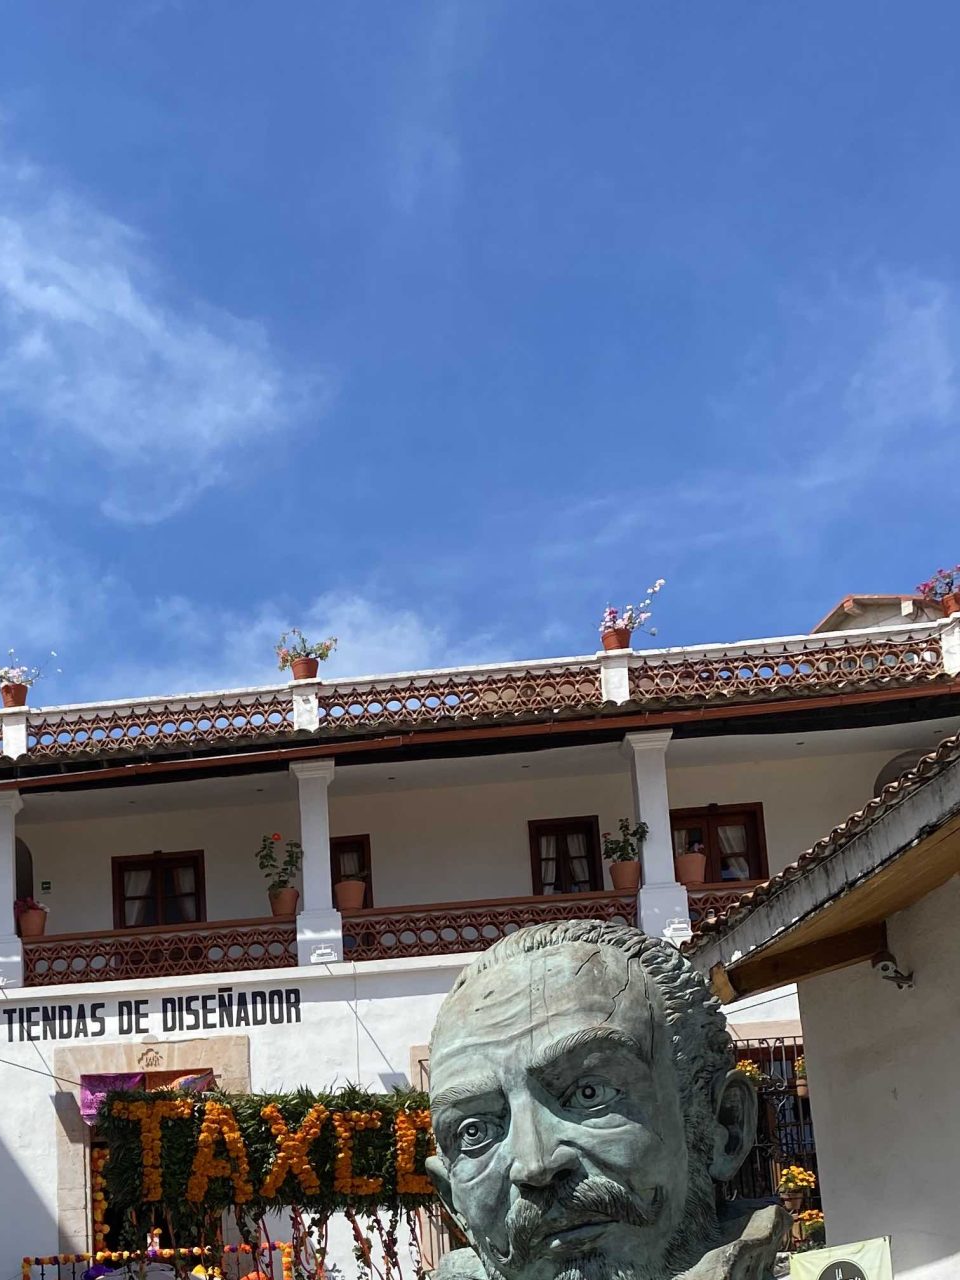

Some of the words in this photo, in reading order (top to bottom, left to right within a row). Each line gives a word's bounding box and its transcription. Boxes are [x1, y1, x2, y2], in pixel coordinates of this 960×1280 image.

[3, 1002, 105, 1042] TIENDAS
[118, 999, 149, 1034] DE
[162, 987, 301, 1032] DISEÑADOR
[835, 1268, 843, 1280] LA
